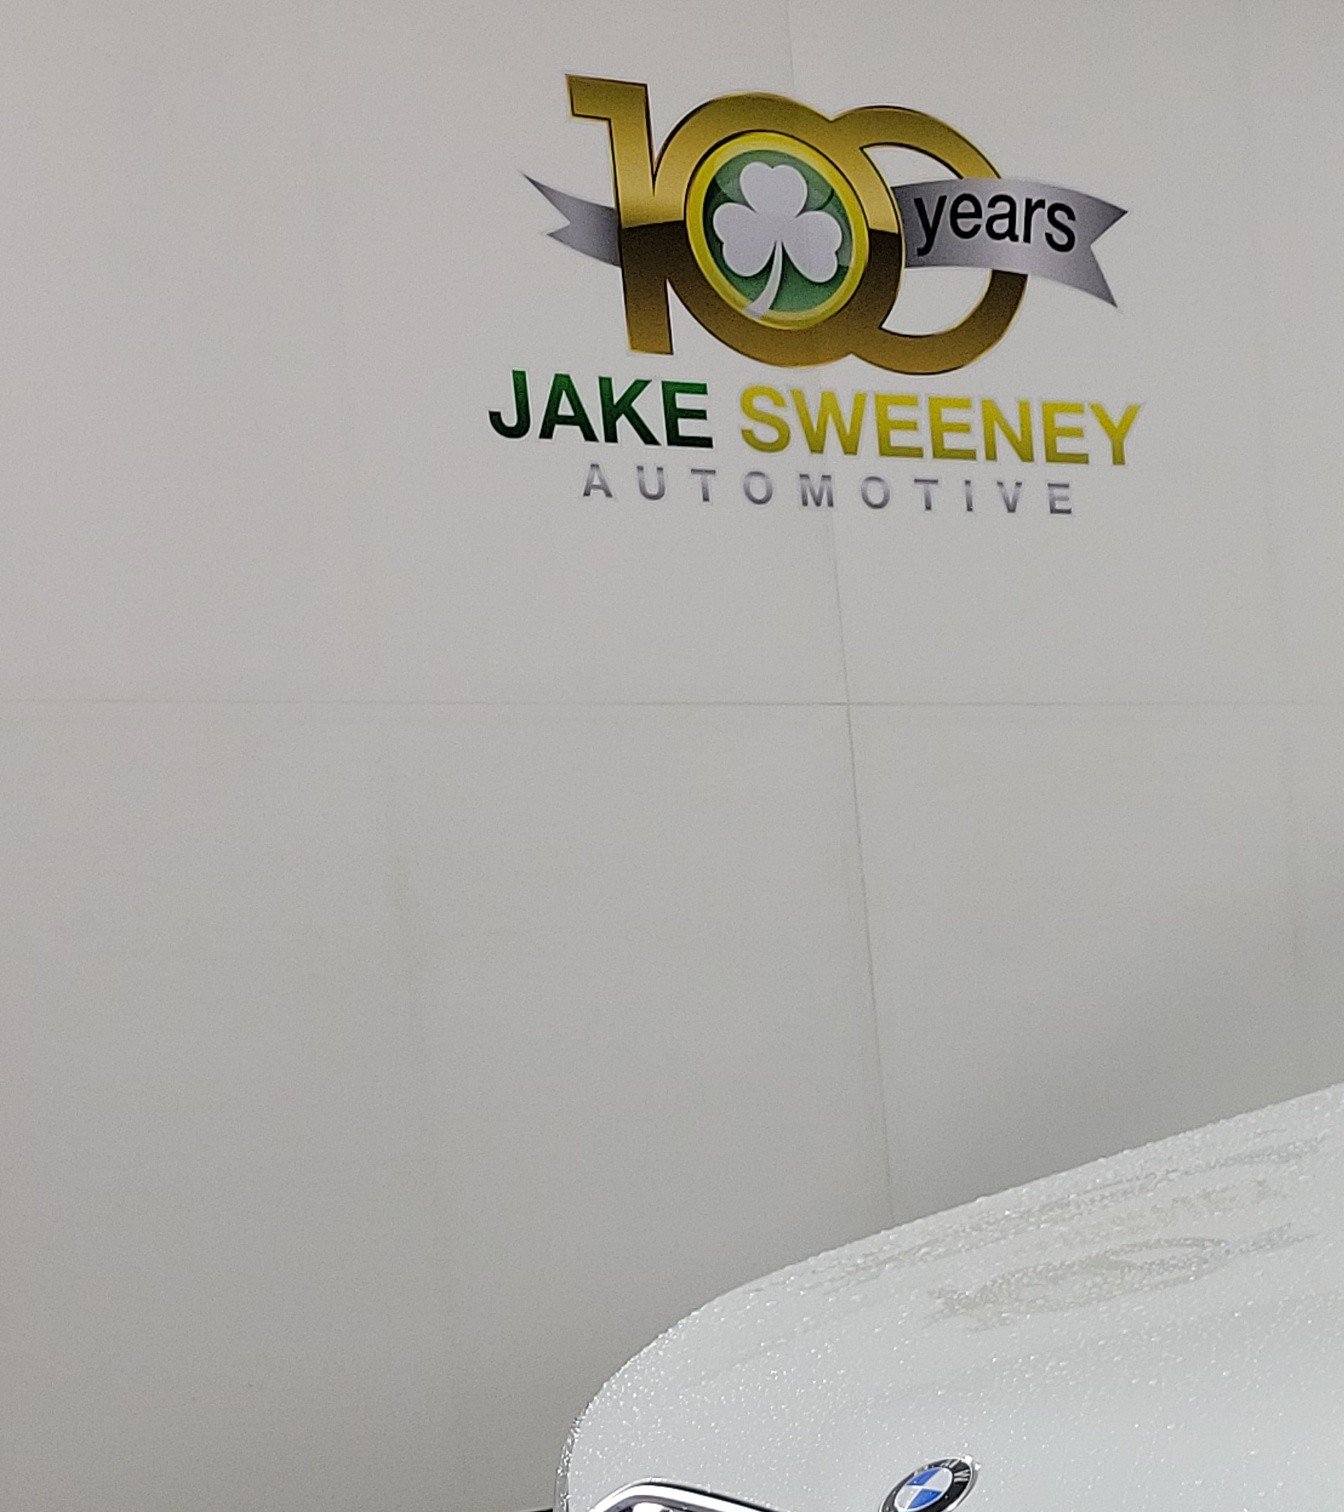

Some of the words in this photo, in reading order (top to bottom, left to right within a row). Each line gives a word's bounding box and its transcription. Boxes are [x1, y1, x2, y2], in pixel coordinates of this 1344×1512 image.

[565, 73, 1028, 375] 100
[913, 193, 1077, 256] years
[488, 369, 714, 448] JAKE
[740, 385, 1143, 466] SWEENEY
[582, 463, 1072, 514] AUTOMOTIVE
